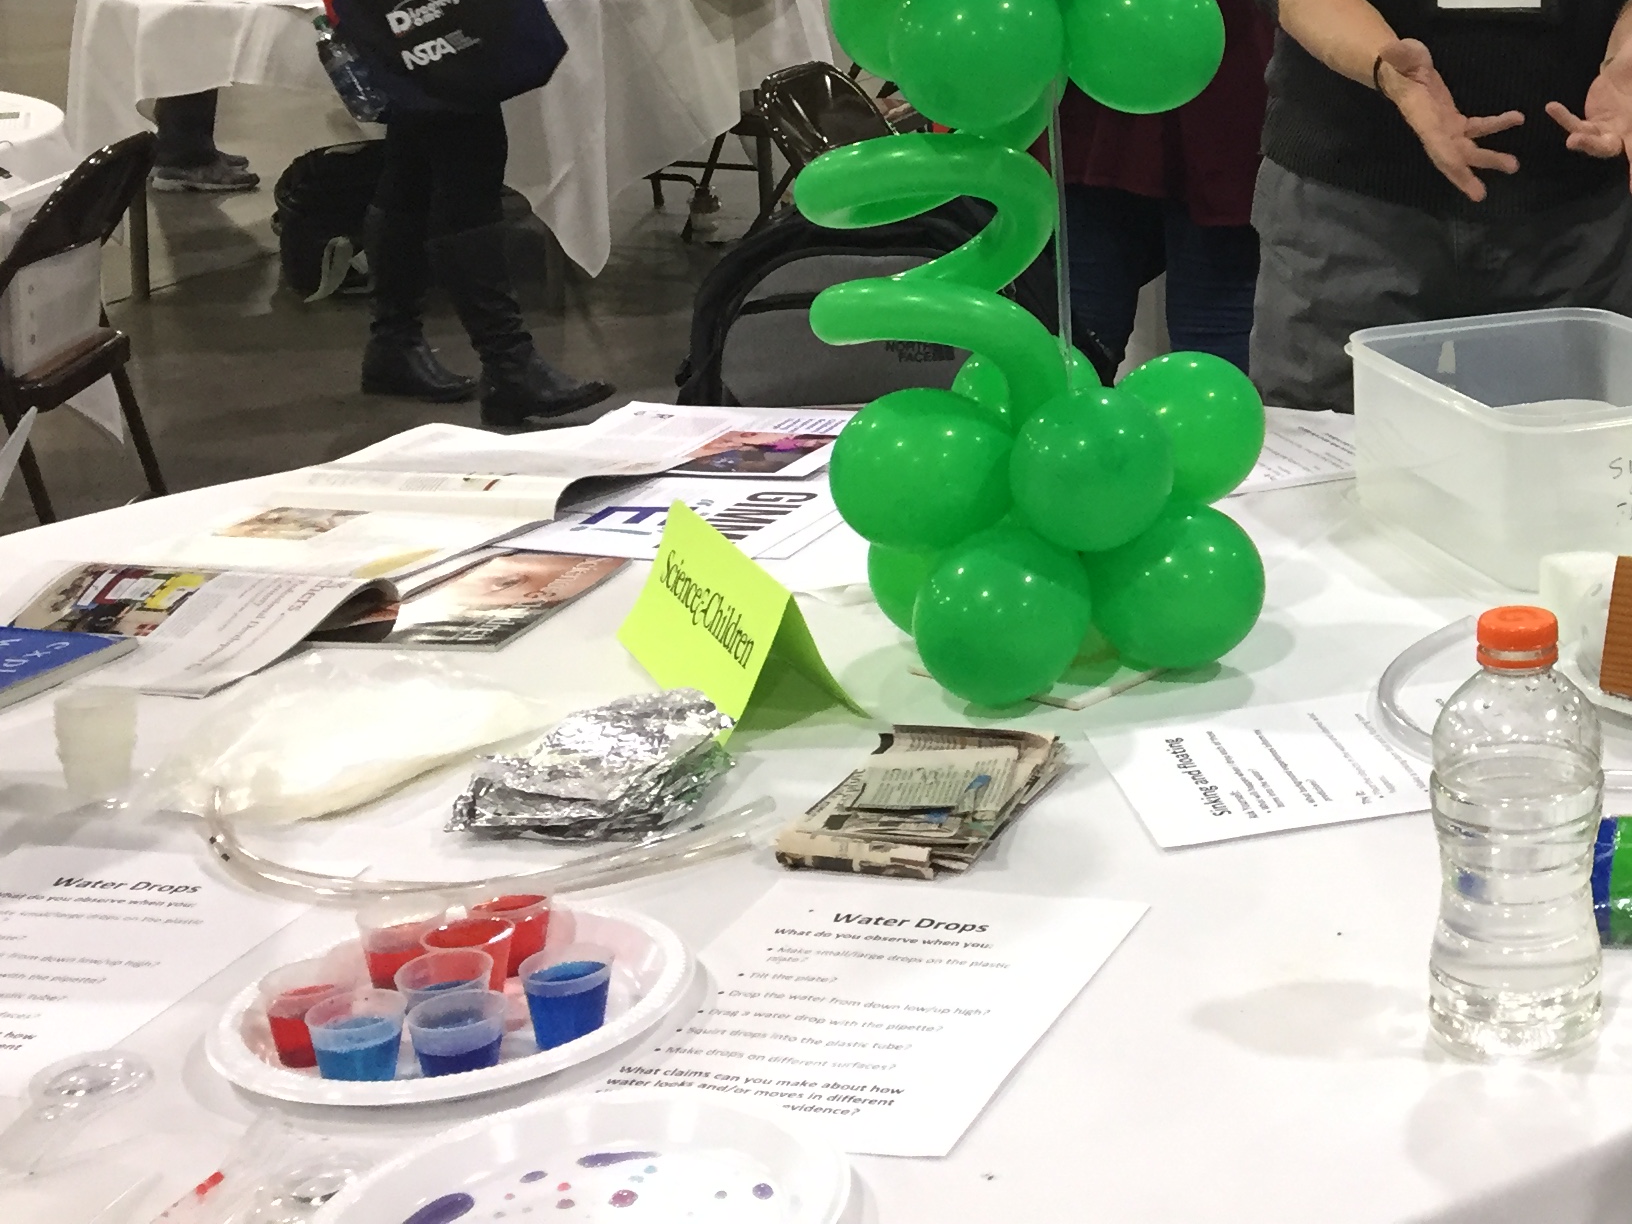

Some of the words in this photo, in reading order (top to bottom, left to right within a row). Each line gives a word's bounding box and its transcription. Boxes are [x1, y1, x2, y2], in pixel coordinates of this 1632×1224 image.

[1164, 737, 1197, 769] floating
[1181, 769, 1209, 785] and
[1199, 785, 1232, 817] Sinking
[53, 877, 128, 890] Water
[129, 881, 202, 894] Drops
[833, 912, 911, 927] Water
[914, 918, 990, 933] Drops
[775, 928, 813, 936] What
[835, 933, 861, 941] you
[864, 934, 918, 944] observe
[923, 938, 959, 946] when
[763, 991, 785, 999] the
[788, 994, 826, 1003] water
[753, 1012, 791, 1020] water
[794, 1014, 827, 1024] drop
[861, 1021, 883, 1029] the
[4, 1031, 37, 1040] how
[800, 1037, 823, 1045] the
[705, 1048, 744, 1059] drops
[768, 1056, 828, 1067] different
[619, 1065, 661, 1075] What
[663, 1068, 711, 1078] claims
[714, 1073, 741, 1082] can
[743, 1076, 773, 1084] you
[776, 1080, 818, 1088] make
[821, 1082, 867, 1092] about
[870, 1085, 905, 1095] how
[606, 1078, 651, 1087] water
[697, 1082, 752, 1096] and/or
[754, 1089, 804, 1099] moves
[807, 1092, 823, 1101] in
[826, 1094, 895, 1107] different
